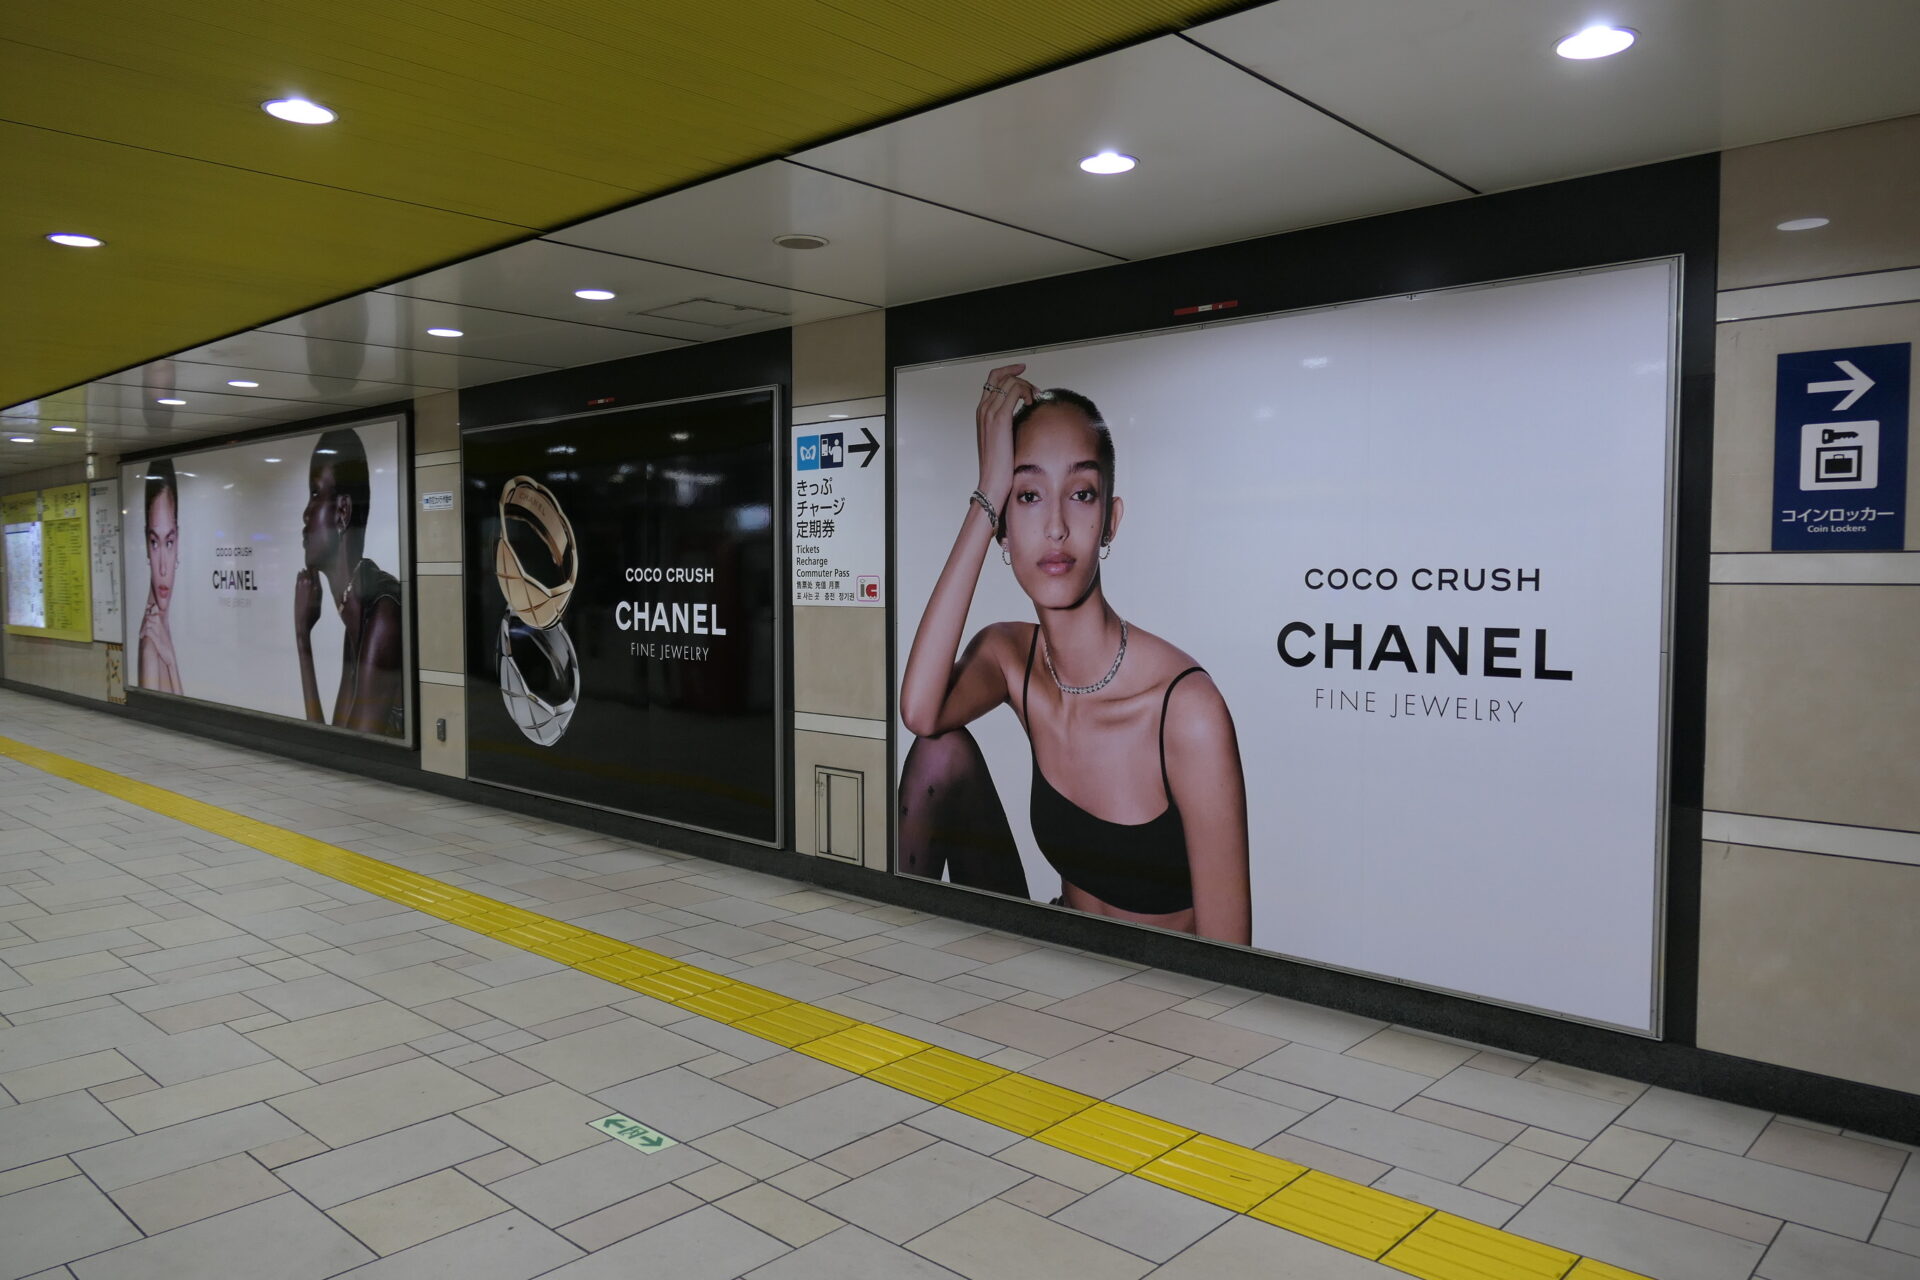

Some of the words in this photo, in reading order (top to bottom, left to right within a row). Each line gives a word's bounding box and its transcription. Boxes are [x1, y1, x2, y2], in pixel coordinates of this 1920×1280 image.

[797, 477, 833, 497] きっぷ
[797, 497, 845, 517] チャージ
[1781, 507, 1895, 522] コインロッカー
[796, 519, 835, 539] 定期券
[1807, 525, 1828, 533] Coin
[1831, 524, 1867, 533] Lockers
[796, 545, 820, 554] Tickets
[796, 557, 828, 567] Recharge
[212, 570, 258, 591] CHANEL
[625, 567, 662, 583] COCO
[665, 567, 714, 583] CRUSH
[796, 569, 832, 578] Commuter
[834, 568, 850, 578] Pass
[1304, 568, 1398, 591] COCO
[1411, 567, 1541, 592] CRUSH
[615, 600, 727, 636] CHANEL
[630, 642, 655, 658] FINE
[659, 644, 709, 661] JEWELRY
[1277, 621, 1573, 681] CHANEL
[1315, 688, 1376, 713] FINE
[1390, 693, 1524, 723] JEWELRY
